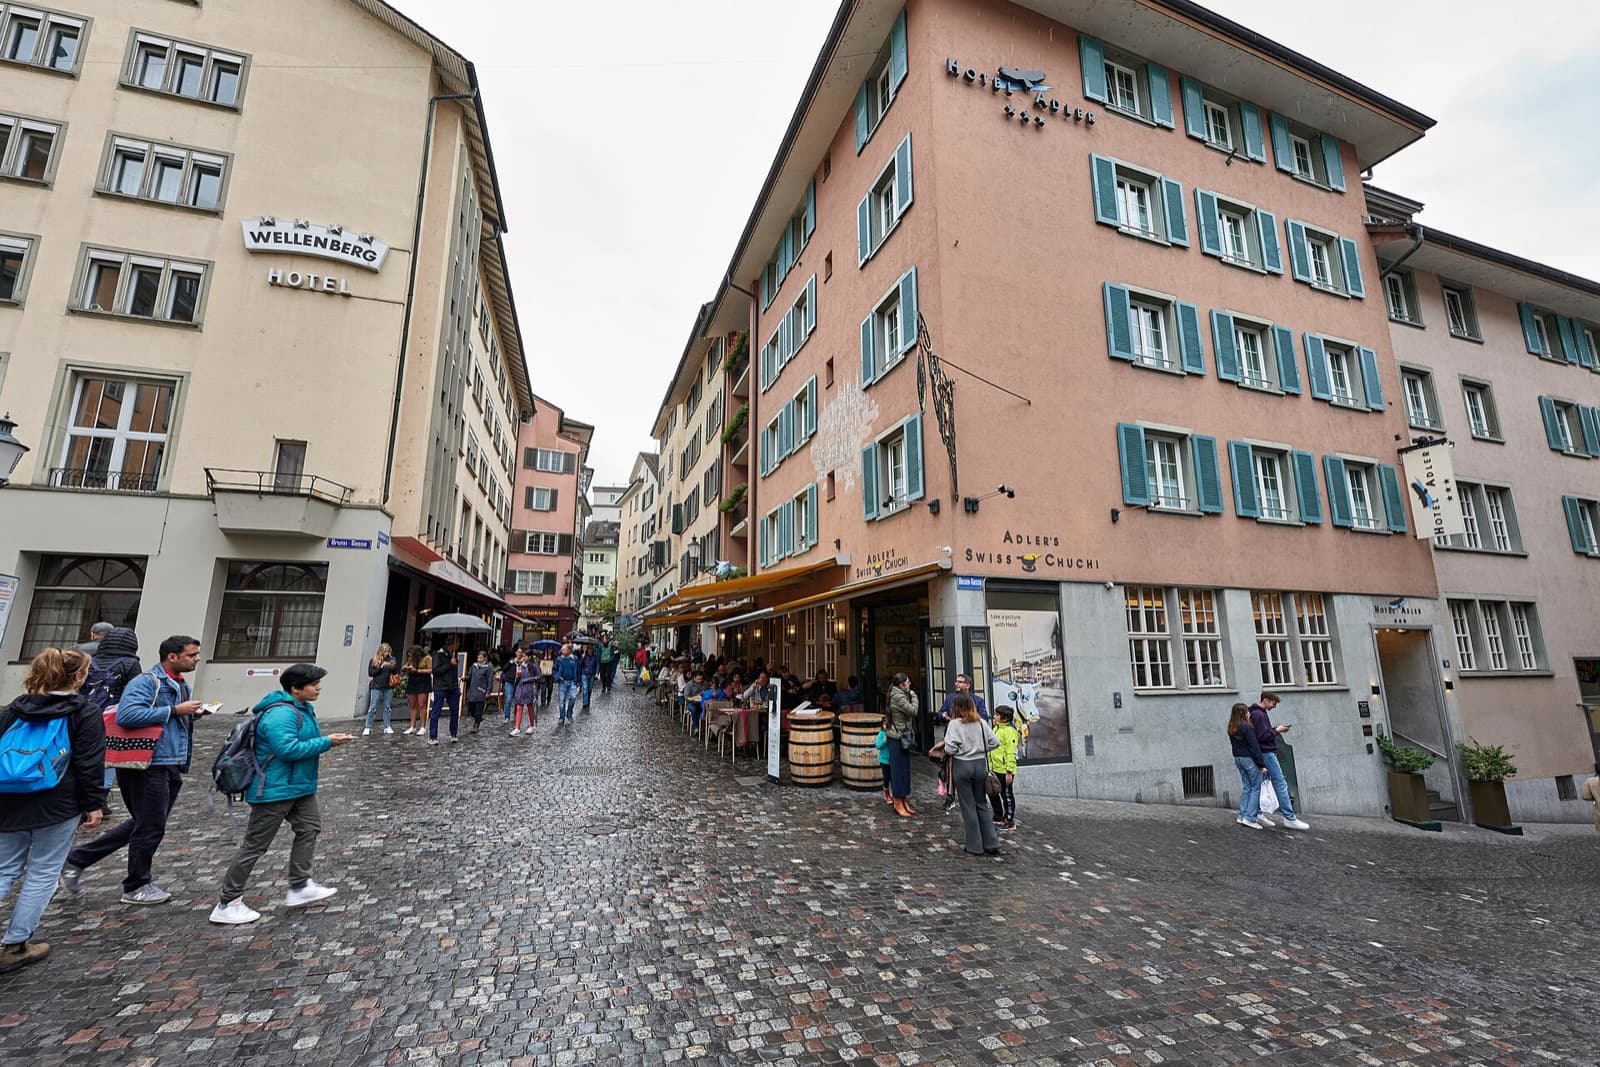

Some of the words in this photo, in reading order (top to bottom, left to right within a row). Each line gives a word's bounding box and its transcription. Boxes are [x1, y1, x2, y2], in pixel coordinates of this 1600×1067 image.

[946, 56, 1013, 97] HOTEL
[1034, 91, 1097, 126] ADLER
[249, 231, 378, 262] WELLENBERG
[267, 266, 353, 297] HOTEL
[1422, 451, 1435, 487] ADLER
[1432, 498, 1445, 535] HOTEL
[1003, 529, 1060, 547] ADLER'S
[856, 566, 871, 578] SWISS
[885, 556, 908, 570] CHUCHI
[867, 549, 895, 565] ADLER'S
[965, 548, 1013, 566] SWISS
[1045, 553, 1100, 570] CHUCHI
[1374, 605, 1395, 615] HOTEL
[1401, 607, 1421, 615] ADLER
